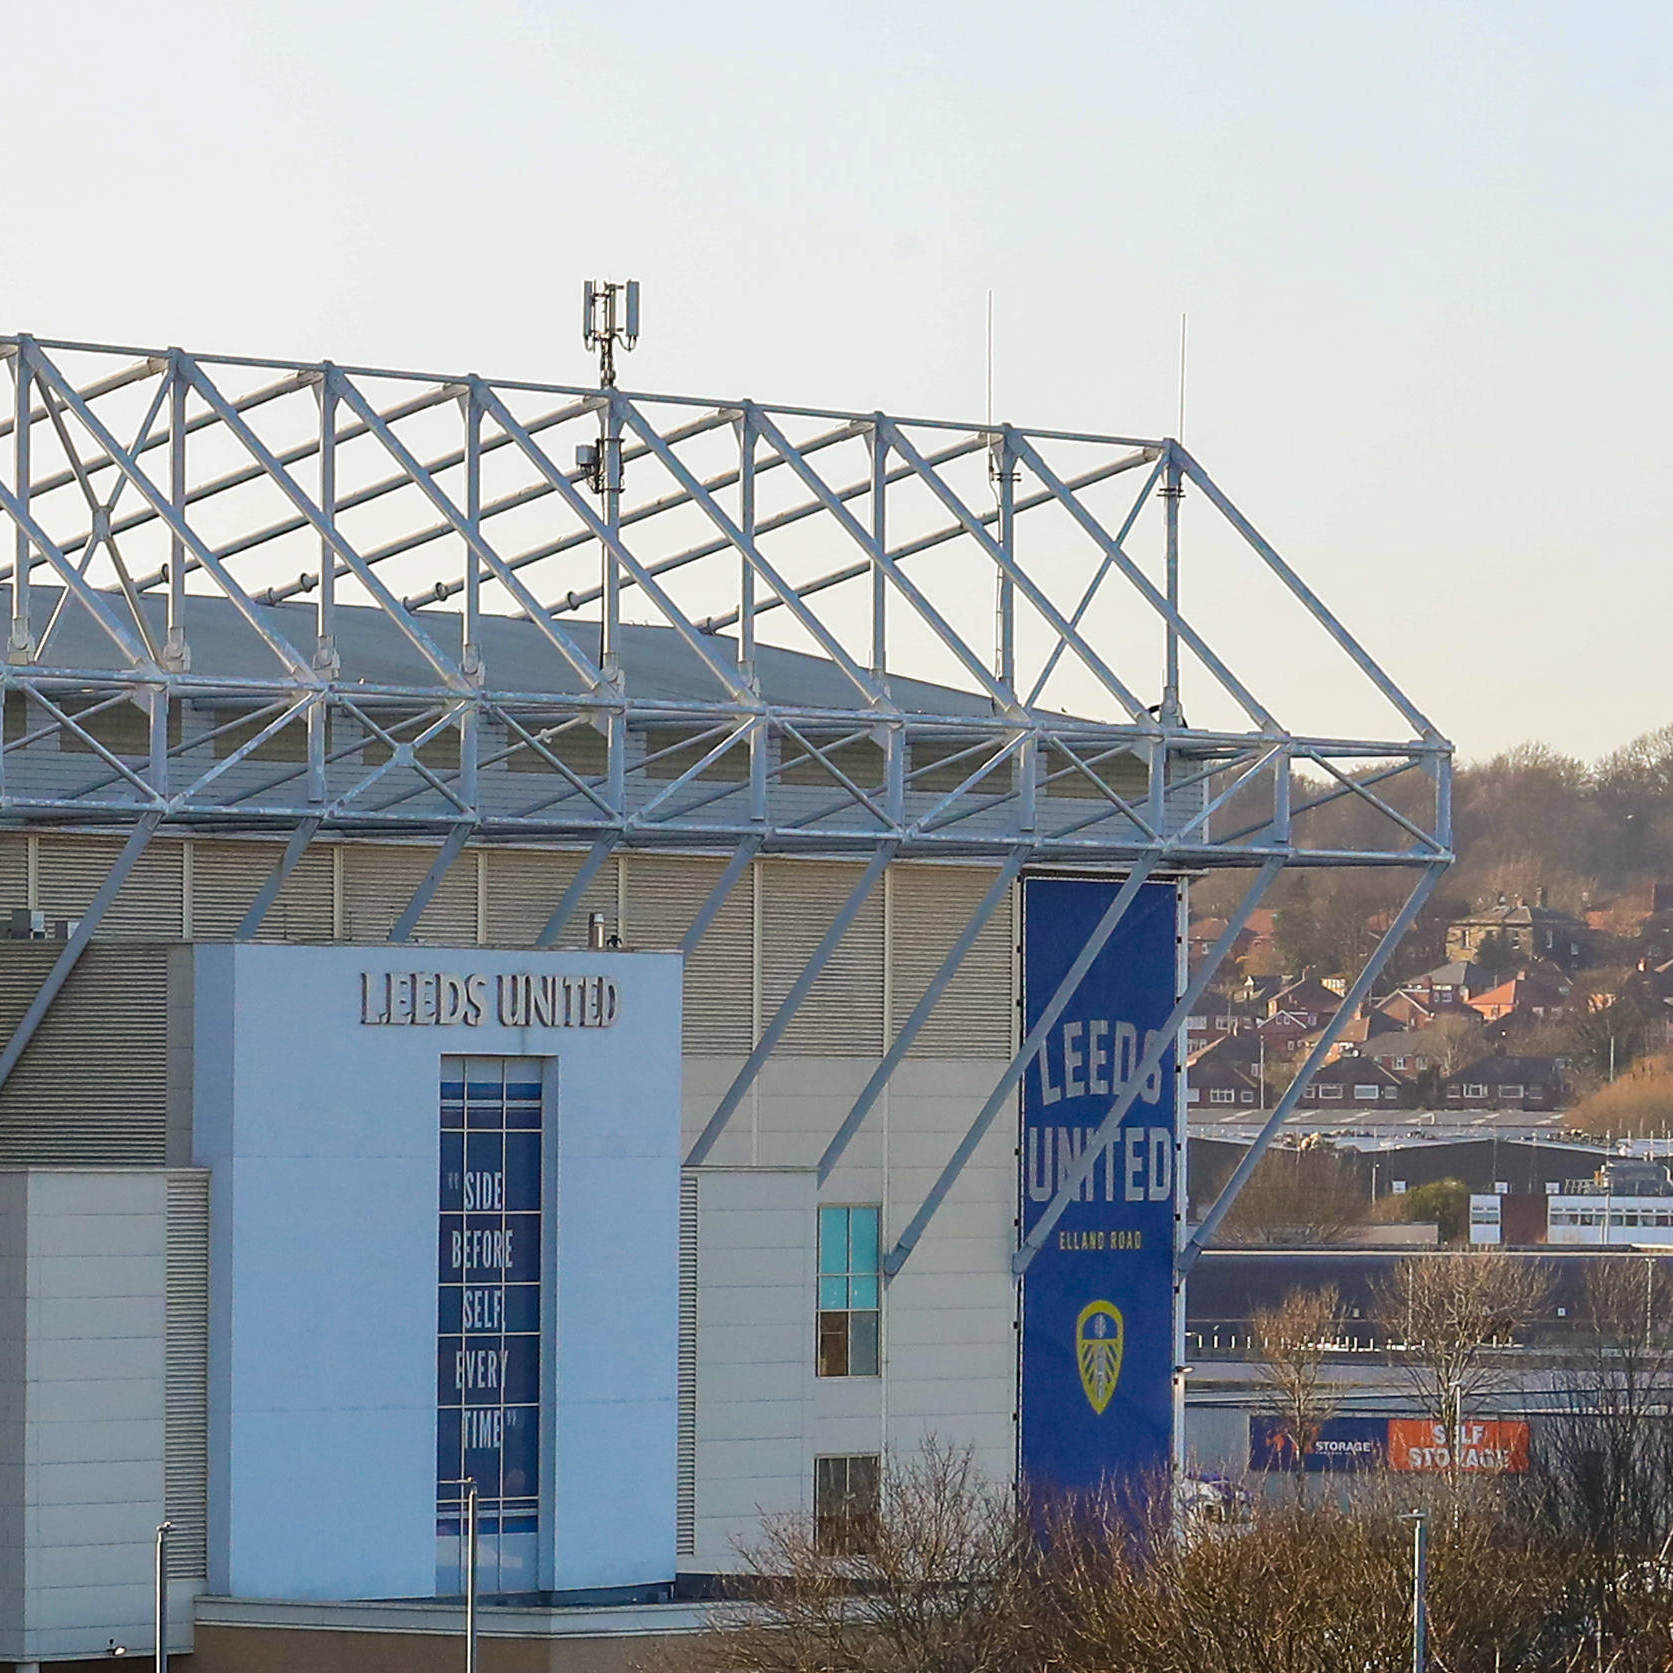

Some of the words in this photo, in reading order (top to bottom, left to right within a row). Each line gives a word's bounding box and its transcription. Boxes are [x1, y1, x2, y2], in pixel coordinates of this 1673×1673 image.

[361, 972, 488, 1027] LEEDS
[497, 972, 622, 1028] UNITED
[1039, 1020, 1163, 1106] LEEDS
[1029, 1127, 1172, 1202] UNITED
[451, 1229, 514, 1269] BEFORE
[1060, 1232, 1104, 1250] ELLAND
[1111, 1232, 1142, 1249] ROAD
[455, 1349, 510, 1390] EVERY
[1315, 1441, 1371, 1452] STORAGE
[1434, 1424, 1484, 1444] SLF
